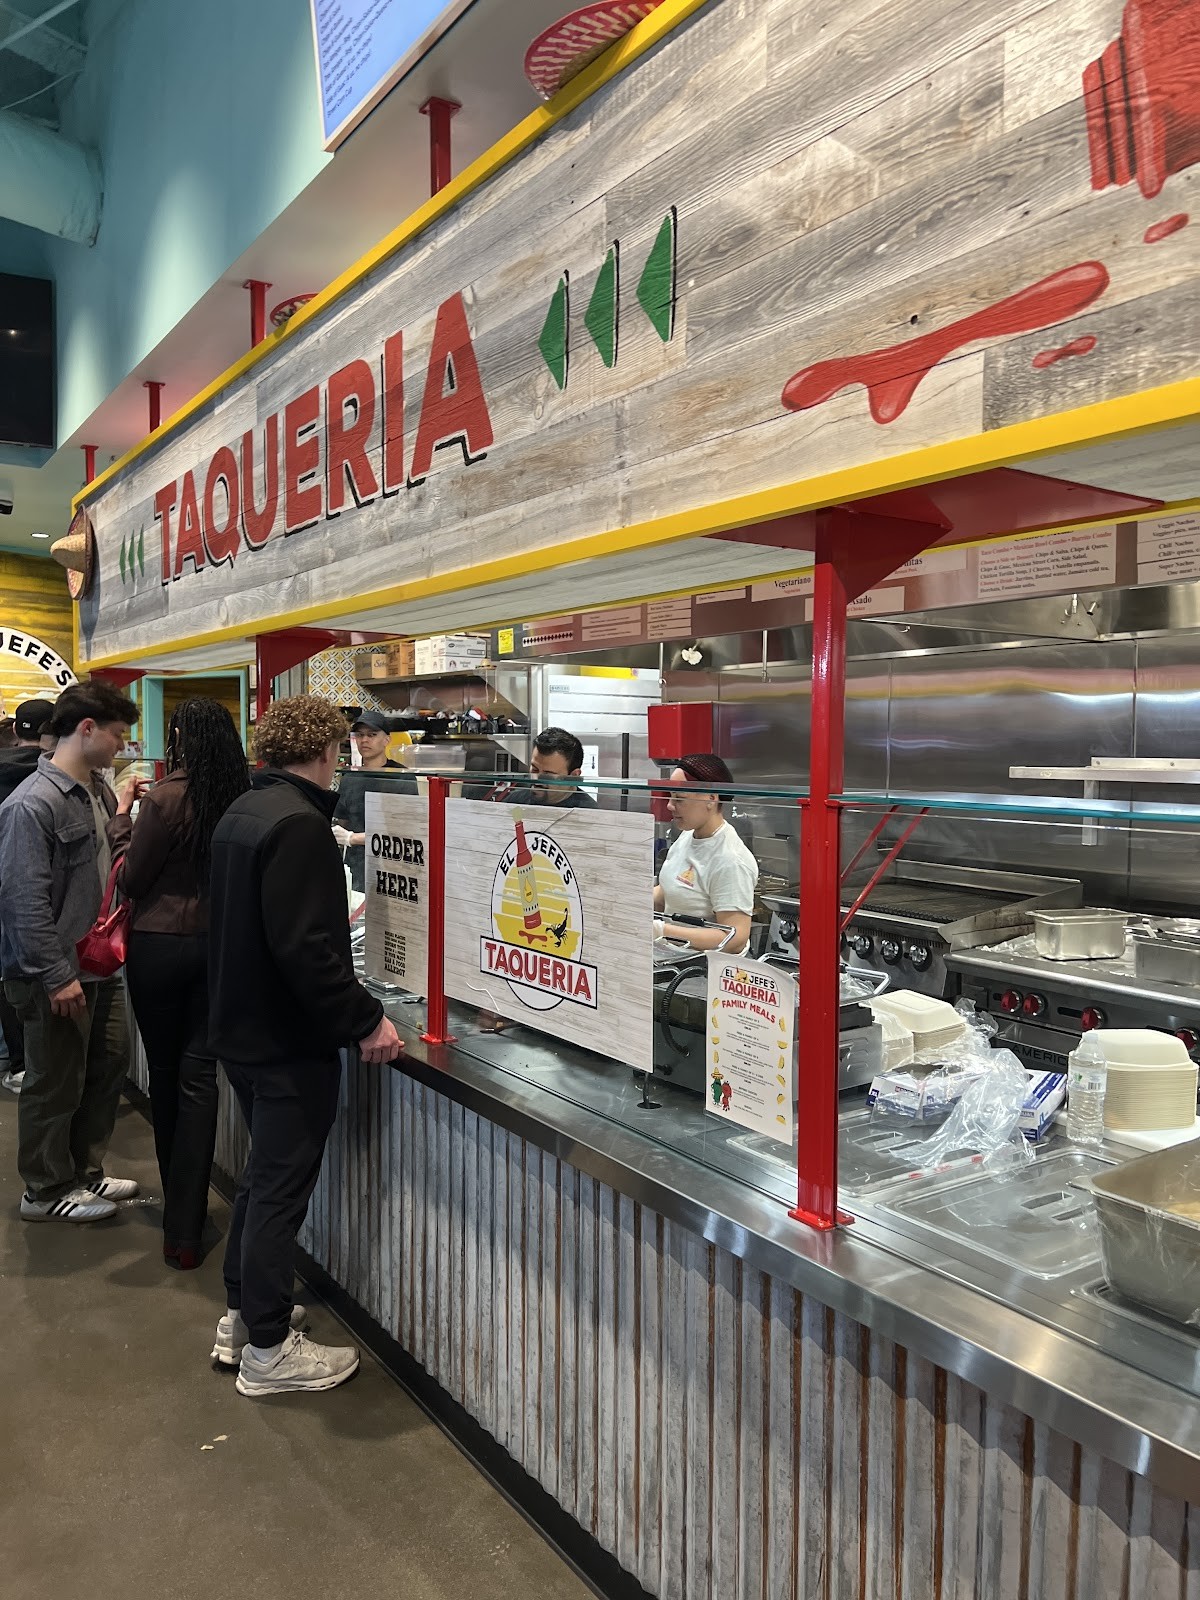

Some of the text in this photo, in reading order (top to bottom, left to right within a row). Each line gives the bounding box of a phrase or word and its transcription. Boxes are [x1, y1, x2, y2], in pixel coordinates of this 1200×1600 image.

[154, 291, 494, 587] TAQUERIA
[774, 577, 812, 588] Vegetariano
[371, 834, 424, 866] ORDER
[500, 852, 515, 876] EL
[532, 836, 573, 886] JEFE'S
[376, 870, 418, 904] HERE
[484, 941, 592, 1001] TAQUERIA
[725, 968, 776, 990] EL JEFE'S
[722, 978, 777, 1006] TAQUERIA
[722, 999, 748, 1010] FAMILY
[750, 1002, 776, 1024] MEALS
[1012, 1045, 1068, 1066] AMERIC
